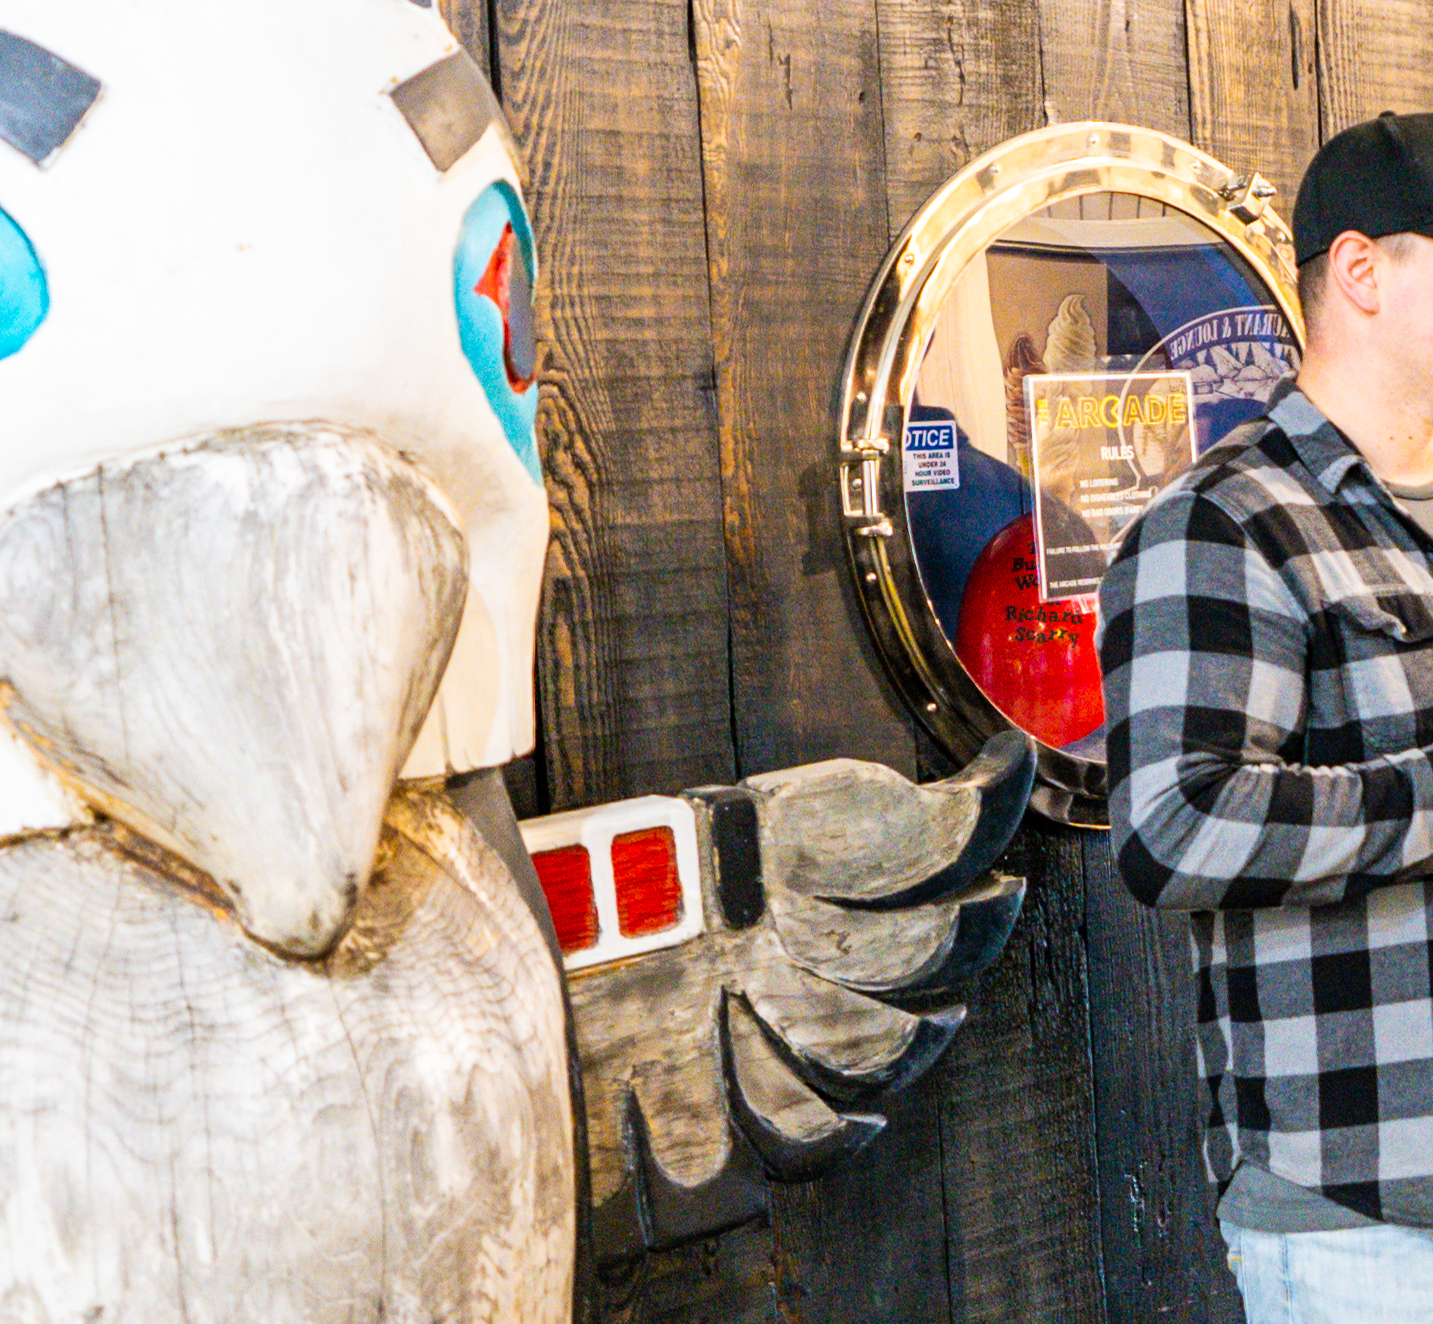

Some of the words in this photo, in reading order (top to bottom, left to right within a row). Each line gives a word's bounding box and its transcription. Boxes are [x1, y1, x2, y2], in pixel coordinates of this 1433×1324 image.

[1054, 393, 1187, 429] ARCADE
[1100, 445, 1135, 461] RULES
[1005, 605, 1083, 625] Richard
[1014, 627, 1080, 648] Scarry
